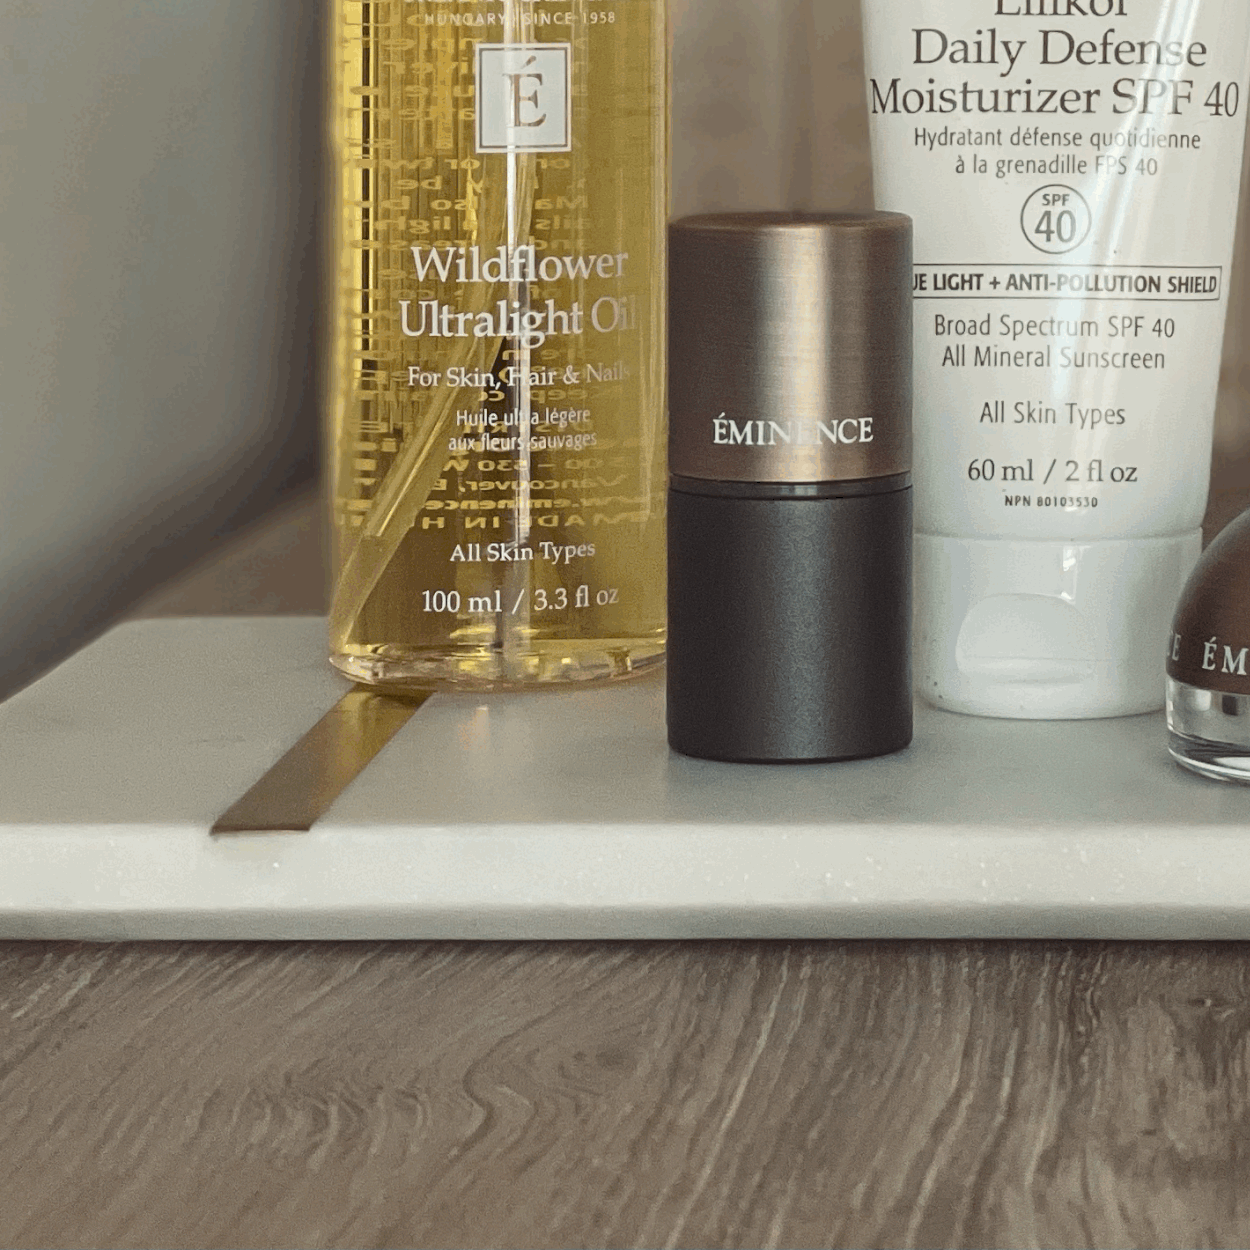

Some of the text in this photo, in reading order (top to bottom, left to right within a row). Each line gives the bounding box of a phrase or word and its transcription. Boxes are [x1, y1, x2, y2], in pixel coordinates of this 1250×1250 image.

[523, 13, 573, 26] SINCE
[582, 11, 615, 24] 1958
[912, 28, 1208, 77] Daily Defense
[502, 54, 547, 128] É
[870, 77, 1240, 118] Moisturizer SPF 40
[914, 126, 1201, 152] Hydratant défense quotidienne
[955, 153, 1159, 178] à la grenadille FPS 40
[1041, 193, 1070, 207] SPF
[1034, 209, 1077, 243] 40
[411, 245, 628, 284] Wildflower
[934, 273, 984, 291] LIGHT
[989, 275, 1001, 290] +
[1005, 273, 1161, 294] ANTI-POLLUTION
[1167, 275, 1217, 293] SHIELD
[398, 300, 583, 350] Ultralight
[934, 315, 1176, 341] Broad Spectrum SPF 40
[942, 346, 1165, 370] All Mineral Sunscreen
[407, 366, 441, 387] For
[446, 366, 501, 391] Skin,
[507, 365, 558, 387] Hair
[562, 364, 581, 385] &
[456, 409, 498, 427] Huile
[545, 407, 591, 429] légère
[979, 401, 1126, 430] All Skin Types
[448, 432, 597, 452] aux fleurs sauvages
[711, 412, 874, 446] ÉMINENCE
[967, 459, 1138, 484] 60 ml / 2 fl oz
[1004, 495, 1031, 507] NPN
[450, 540, 595, 565] All Skin Types
[422, 584, 620, 616] 100 ml / 3.3 fl oz
